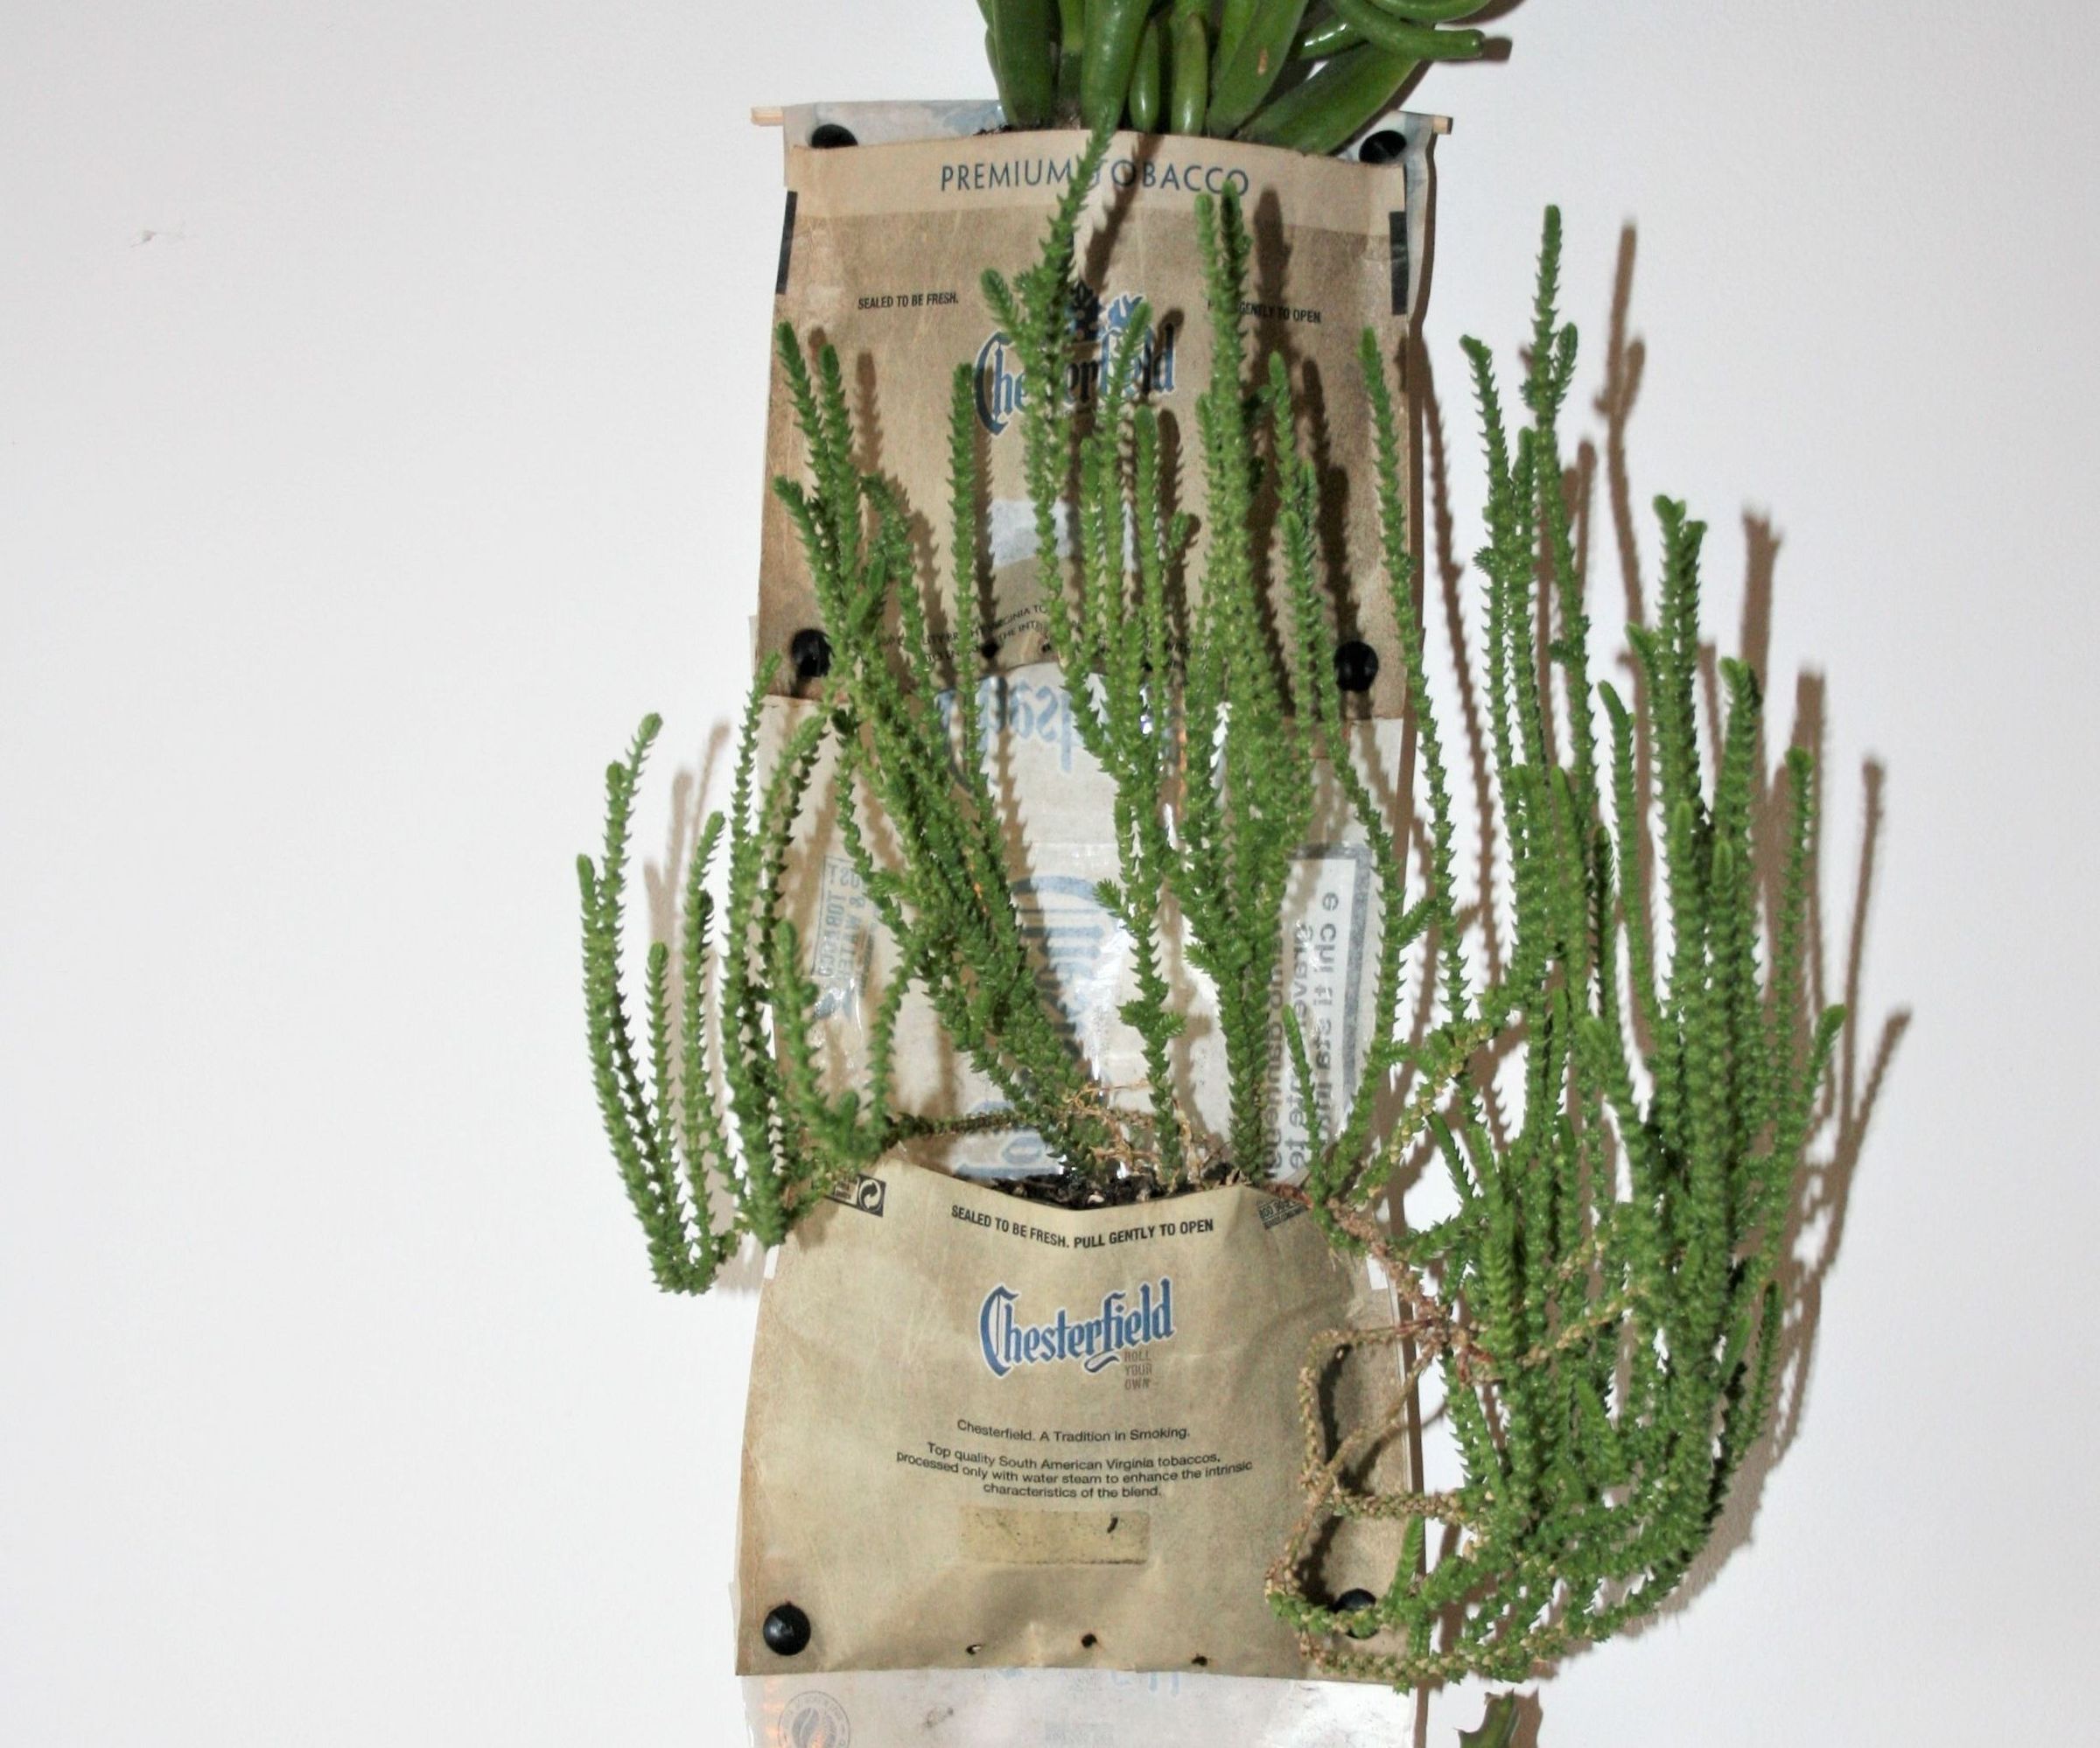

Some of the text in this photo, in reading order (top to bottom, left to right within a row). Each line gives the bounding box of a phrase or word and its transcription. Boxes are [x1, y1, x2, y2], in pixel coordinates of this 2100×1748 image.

[941, 158, 1250, 196] PREMIUM TOBACCO
[858, 291, 959, 310] SEALED TO BE FRESH.
[1293, 309, 1322, 324] OPEN
[951, 1205, 1214, 1249] SEALED TO BE FRESH. PULL GENTLY TO OPEN
[980, 1276, 1175, 1377] Chesterfield
[1124, 1350, 1152, 1363] ROLL
[1124, 1364, 1152, 1376] YOUR
[1124, 1378, 1151, 1391] OWN
[956, 1418, 1191, 1443] Chesterfield. A Tradition in Smoking.
[896, 1451, 1254, 1485] processed only with water steam to enhance the intrinsic
[927, 1442, 951, 1458] Top
[954, 1450, 996, 1468] quality
[998, 1455, 1038, 1470] South
[1040, 1458, 1103, 1472] American
[1106, 1457, 1155, 1472] Virginia
[983, 1483, 1162, 1499] characteristics of the blend.
